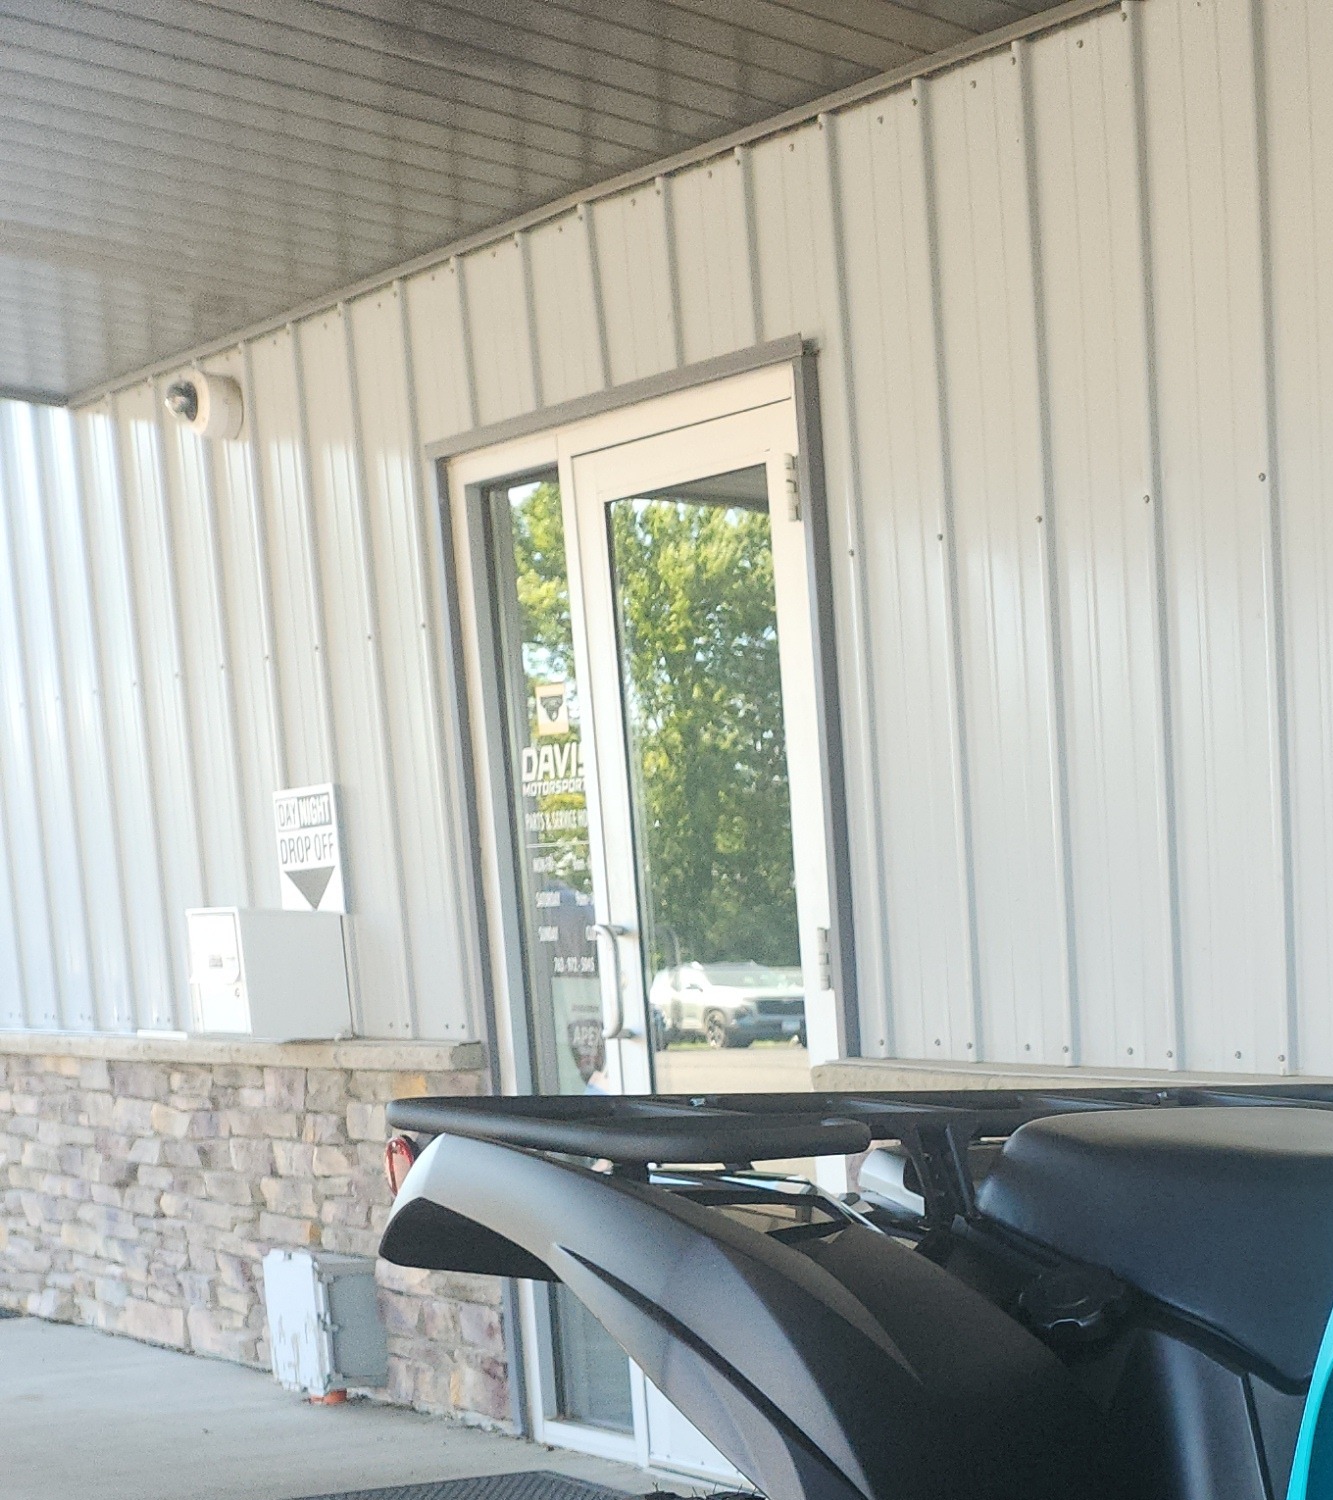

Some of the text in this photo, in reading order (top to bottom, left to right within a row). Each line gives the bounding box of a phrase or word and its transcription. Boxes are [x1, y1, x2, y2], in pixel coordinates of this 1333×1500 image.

[278, 794, 331, 827] DAY NIGHT
[280, 833, 334, 864] DROP OFF
